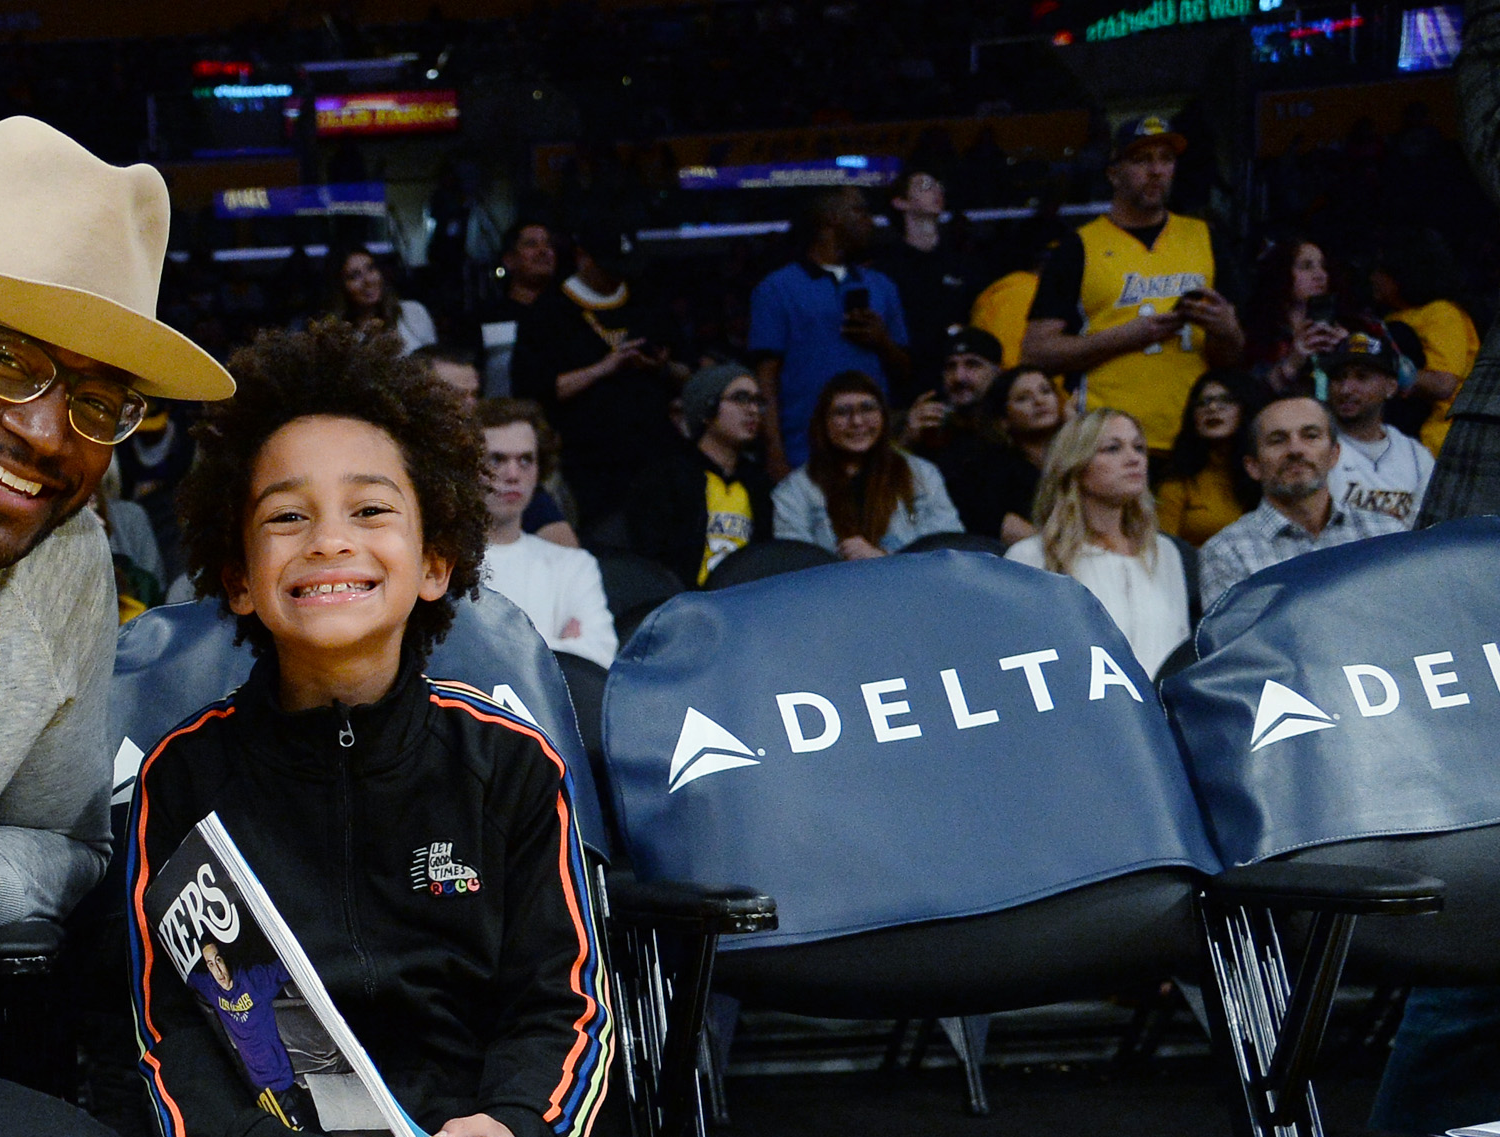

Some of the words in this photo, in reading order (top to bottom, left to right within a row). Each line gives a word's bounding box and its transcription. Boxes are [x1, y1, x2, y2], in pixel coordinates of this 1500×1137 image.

[776, 645, 1145, 754] DELTA
[430, 855, 451, 868] GOOD
[432, 865, 466, 880] TIMES
